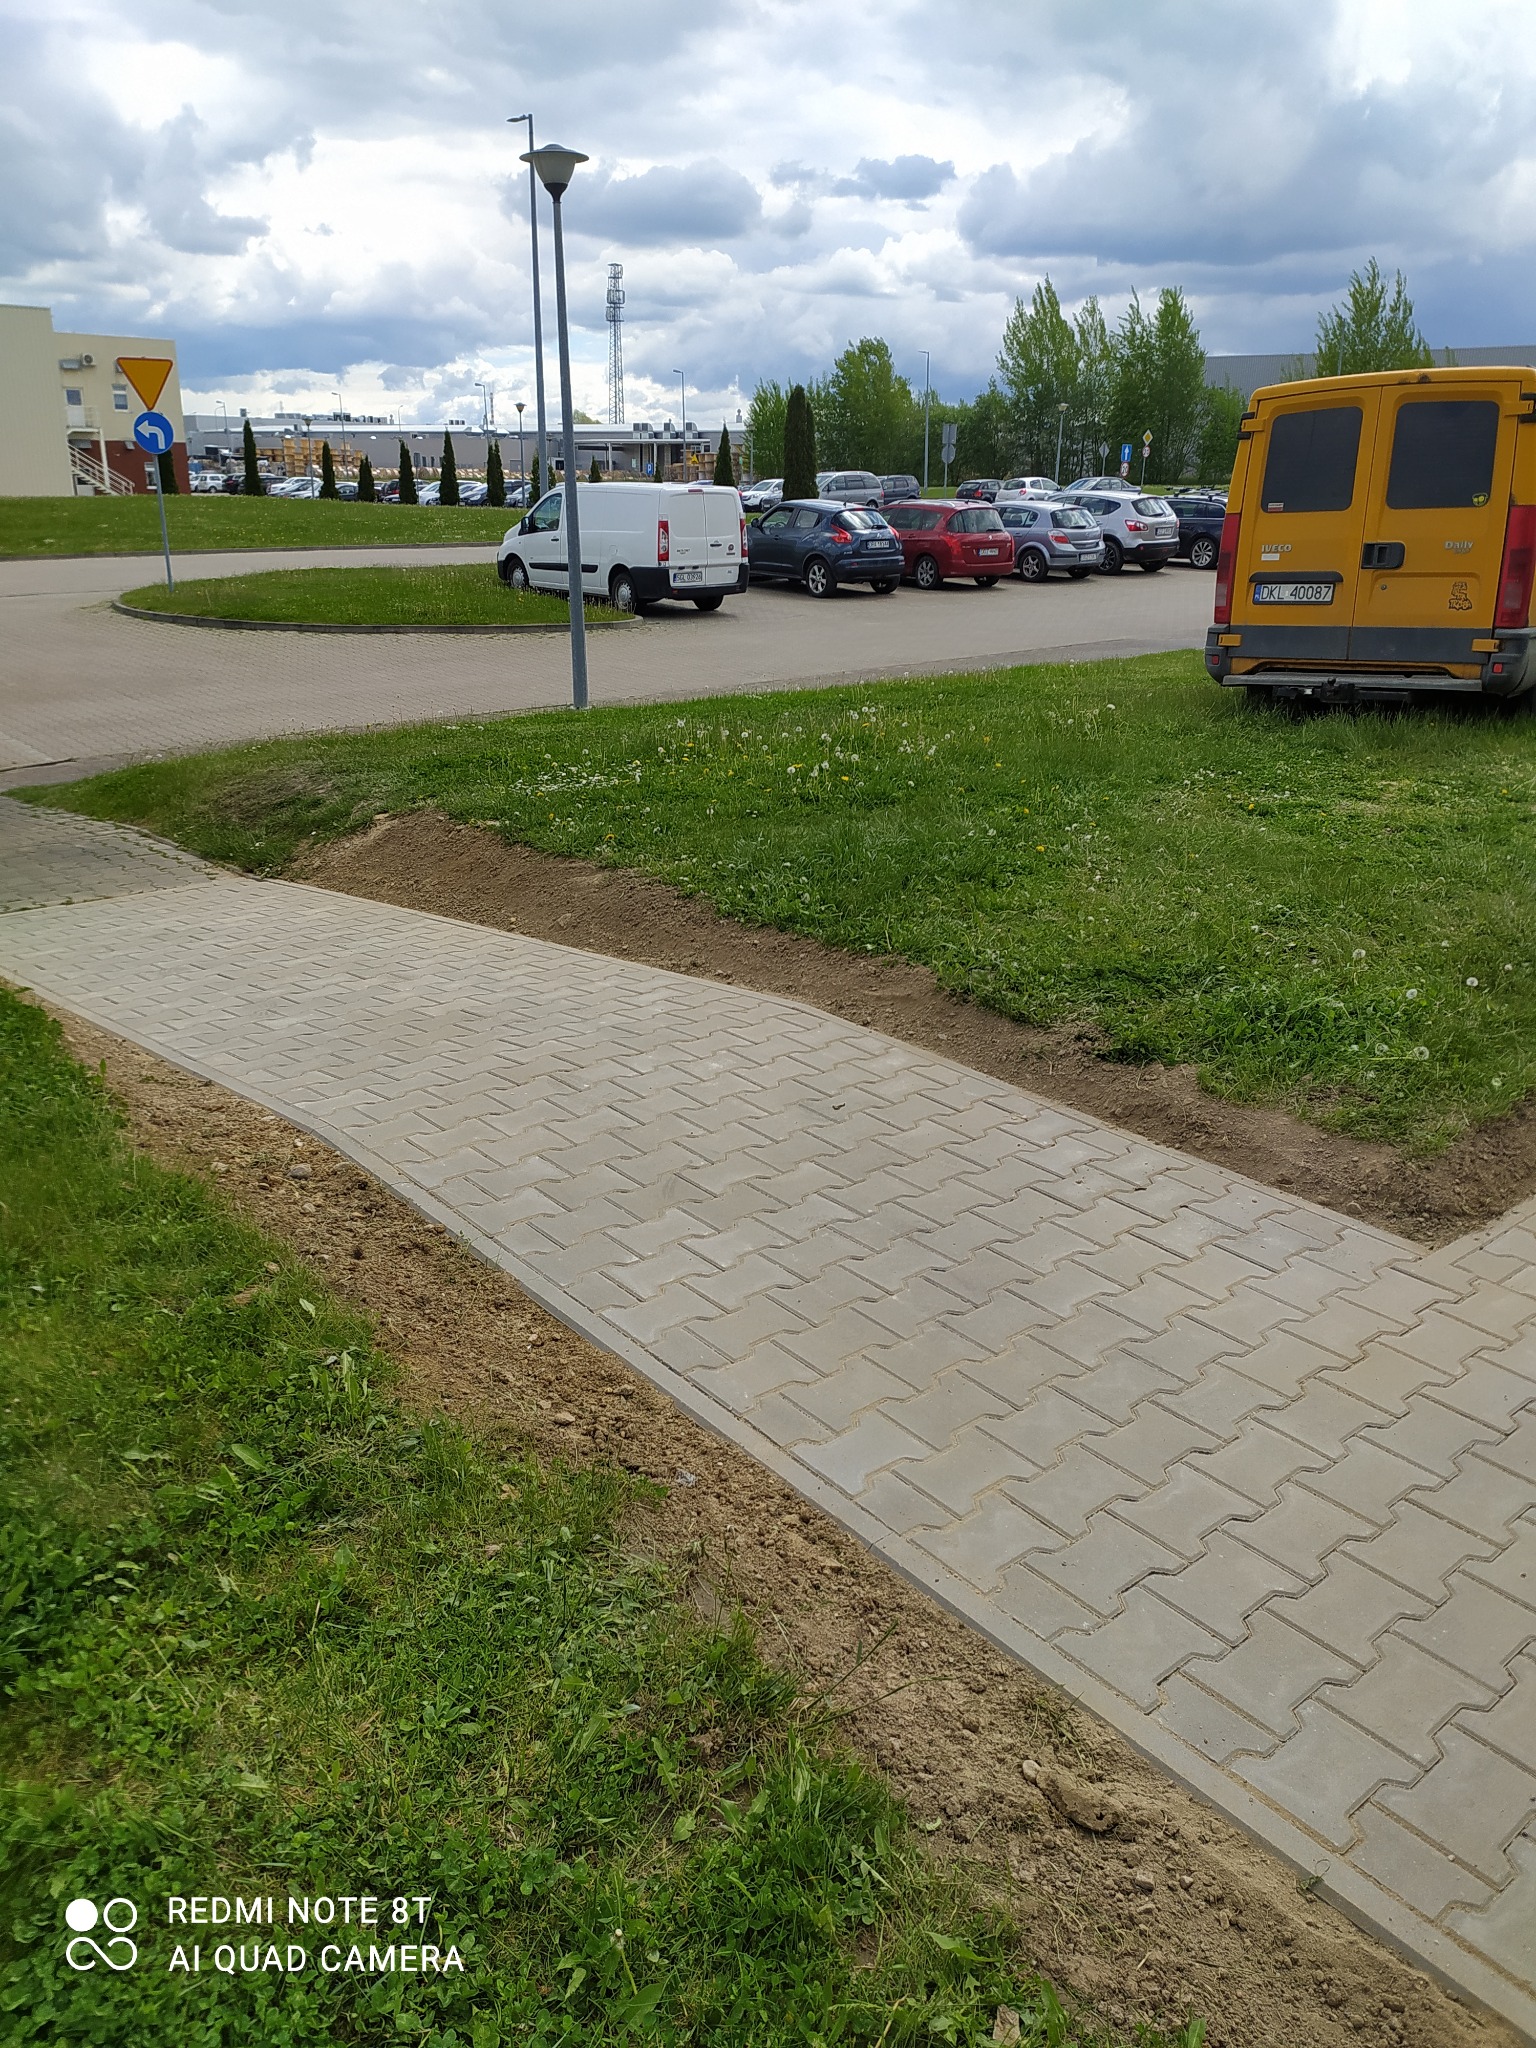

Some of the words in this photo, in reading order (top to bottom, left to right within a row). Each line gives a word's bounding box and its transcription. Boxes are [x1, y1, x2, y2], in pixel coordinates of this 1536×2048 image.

[1261, 544, 1292, 553] IVECO
[1444, 540, 1473, 550] Daily
[1261, 586, 1284, 600] DKL
[1290, 586, 1331, 600] 40087
